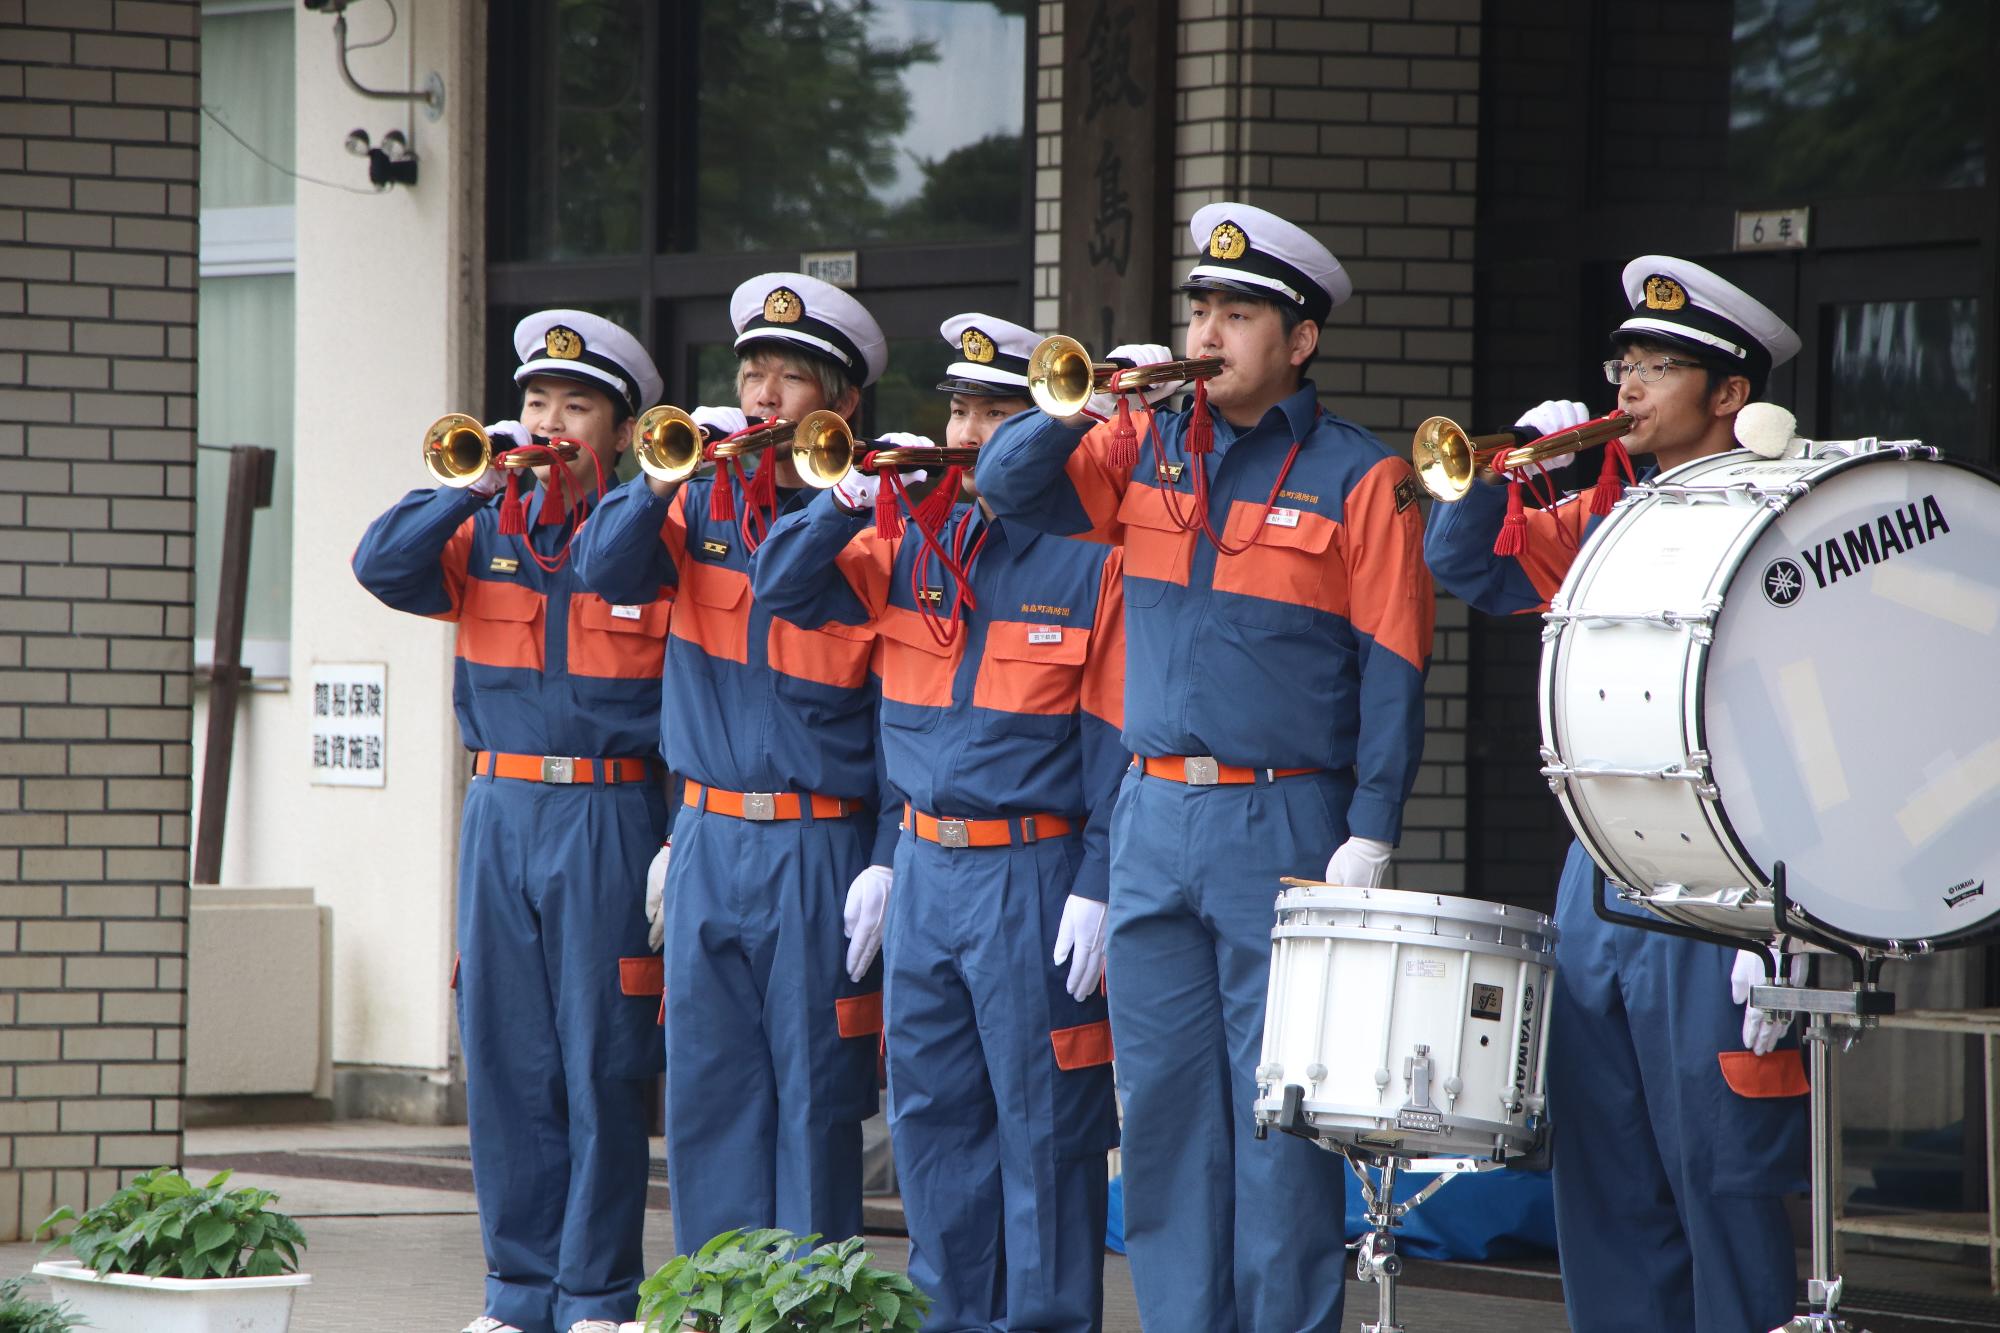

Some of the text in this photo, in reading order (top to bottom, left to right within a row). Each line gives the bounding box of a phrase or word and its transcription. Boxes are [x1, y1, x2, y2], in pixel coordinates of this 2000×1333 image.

[1801, 494, 1950, 589] YAMAHA
[314, 683, 381, 716] 簡易保険
[314, 735, 381, 768] 融資施設
